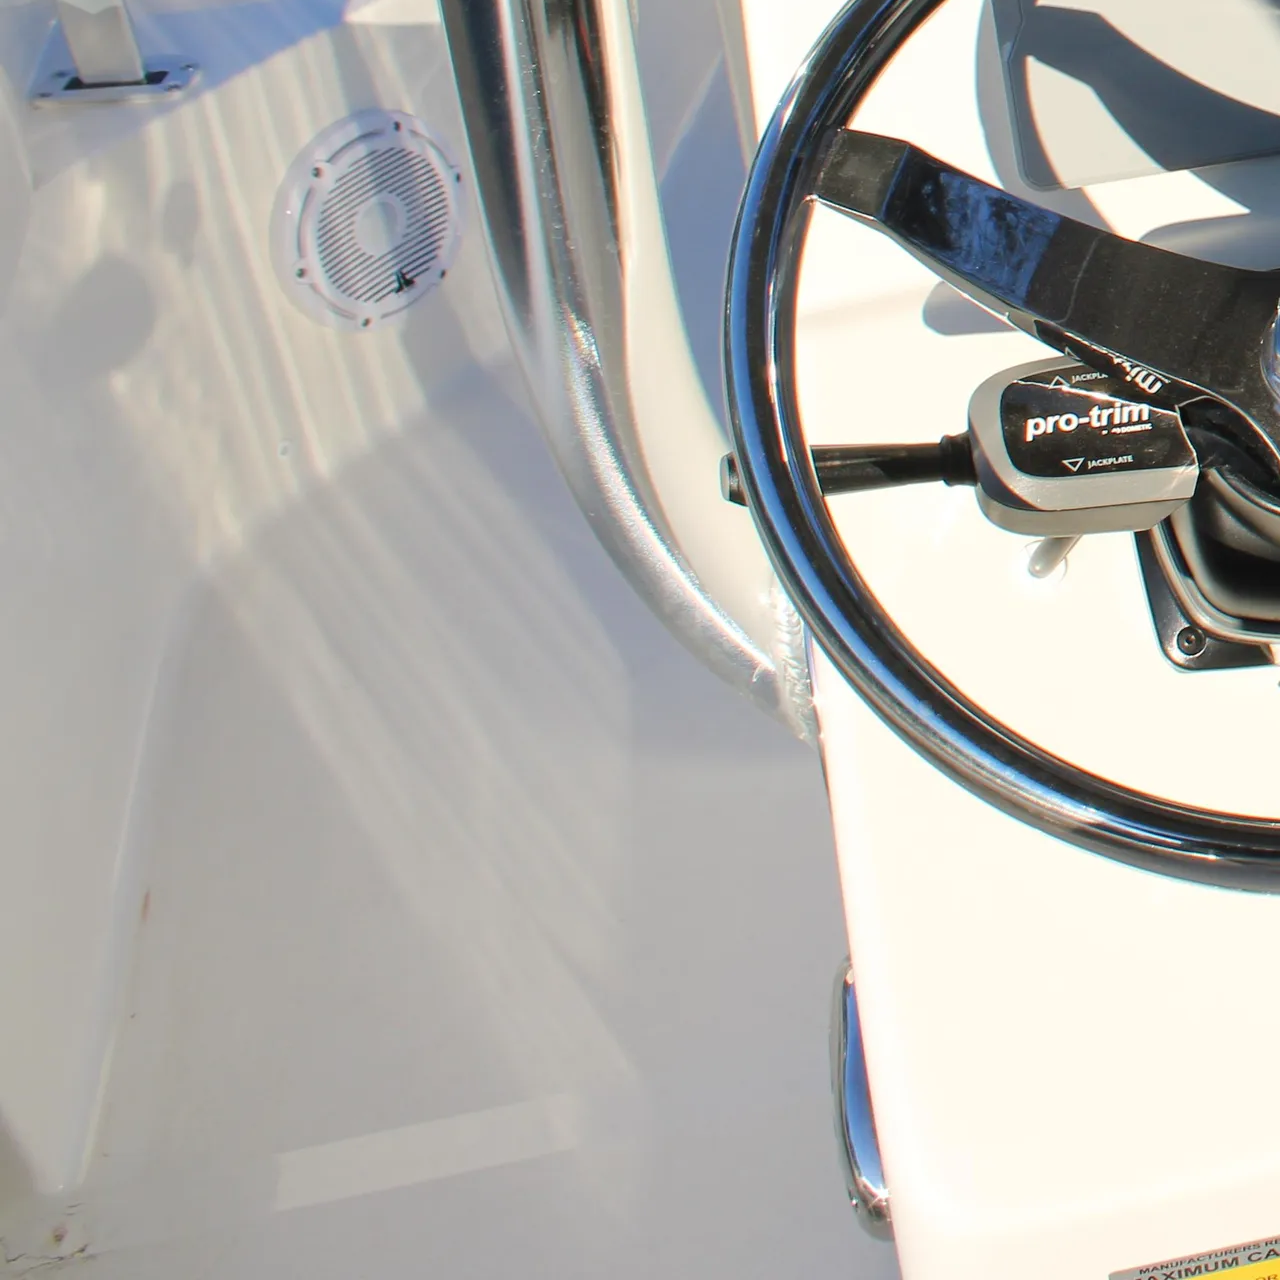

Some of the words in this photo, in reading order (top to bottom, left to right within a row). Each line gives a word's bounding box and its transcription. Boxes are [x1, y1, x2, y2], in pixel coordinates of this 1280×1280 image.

[1072, 372, 1109, 384] JACKPLA
[1024, 402, 1150, 443] pro-trim
[1088, 454, 1133, 469] JACKPLATE
[1139, 1240, 1262, 1275] MANUFACTURERS
